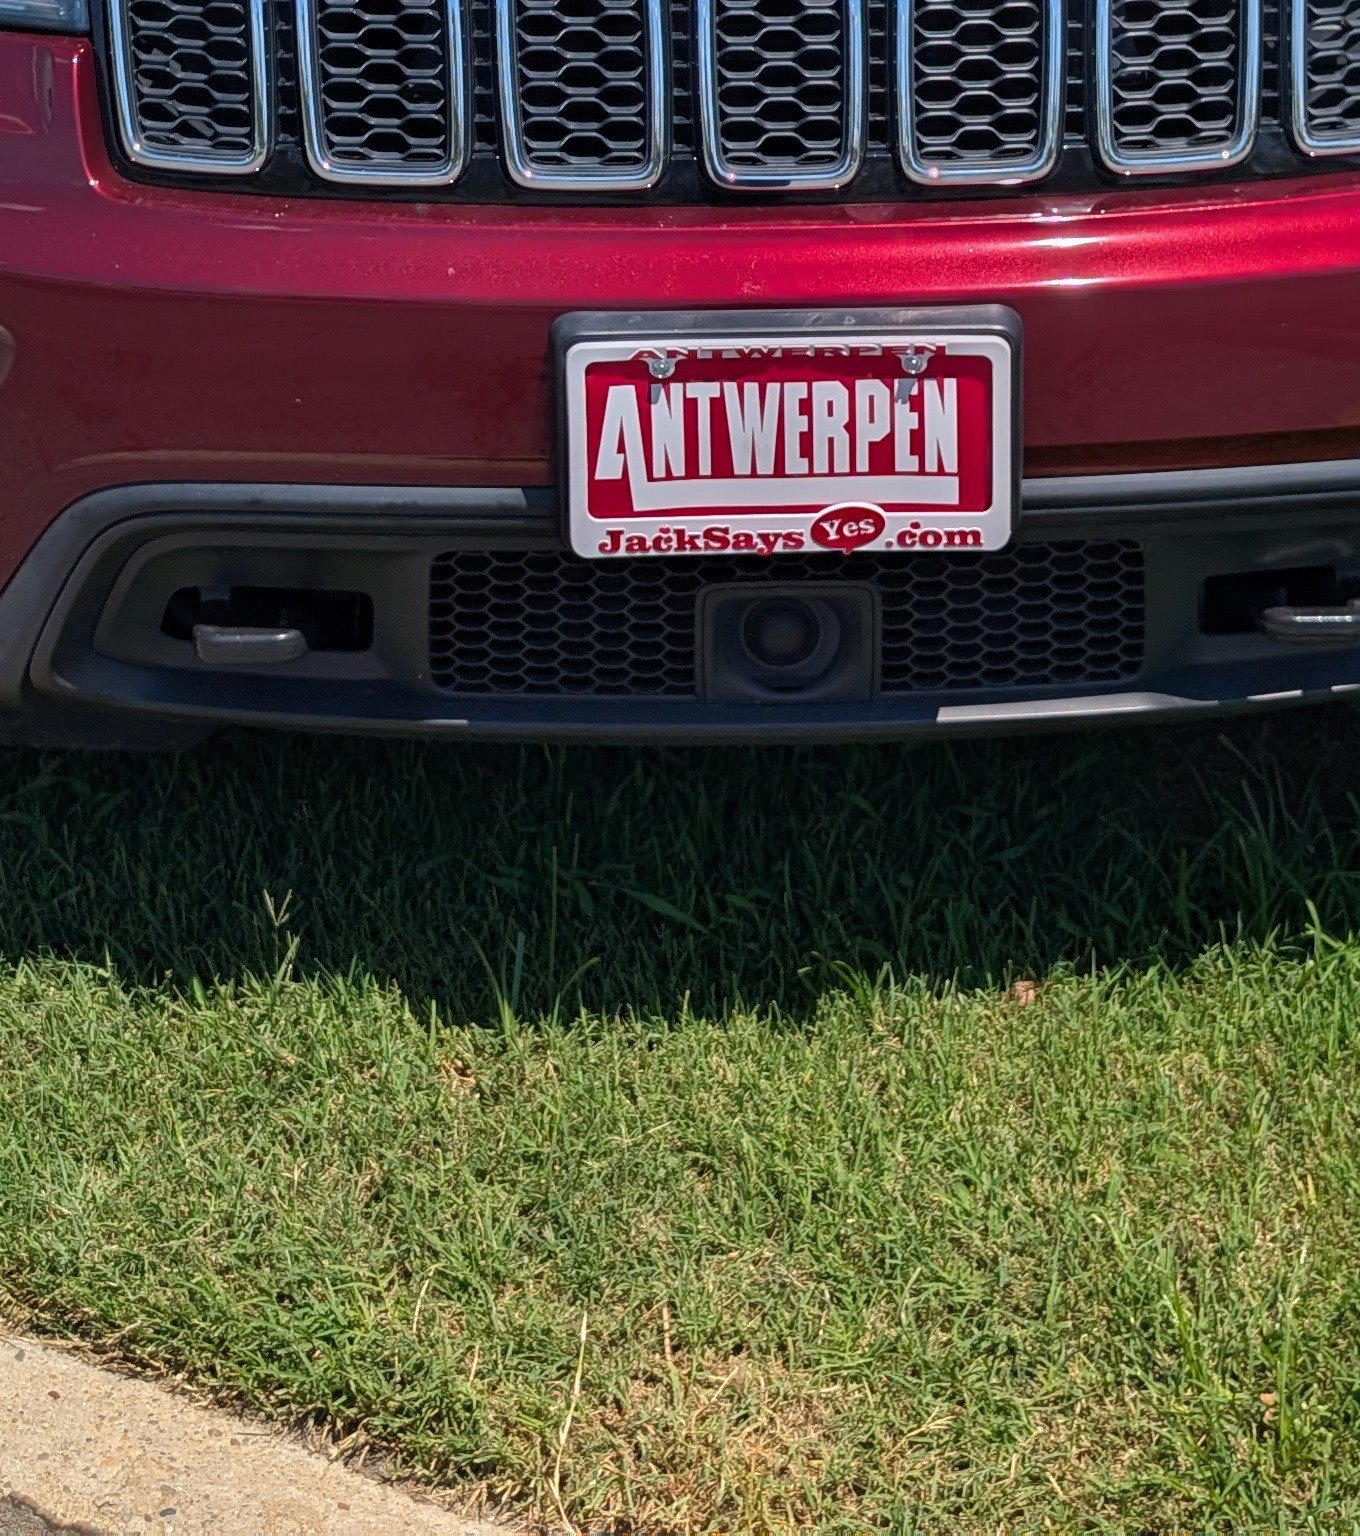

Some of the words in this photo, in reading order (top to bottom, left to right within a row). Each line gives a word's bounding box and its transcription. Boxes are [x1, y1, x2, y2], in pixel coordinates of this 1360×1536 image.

[594, 377, 960, 511] ANTWERPEN
[597, 524, 806, 557] JackSays
[821, 516, 876, 542] Yes
